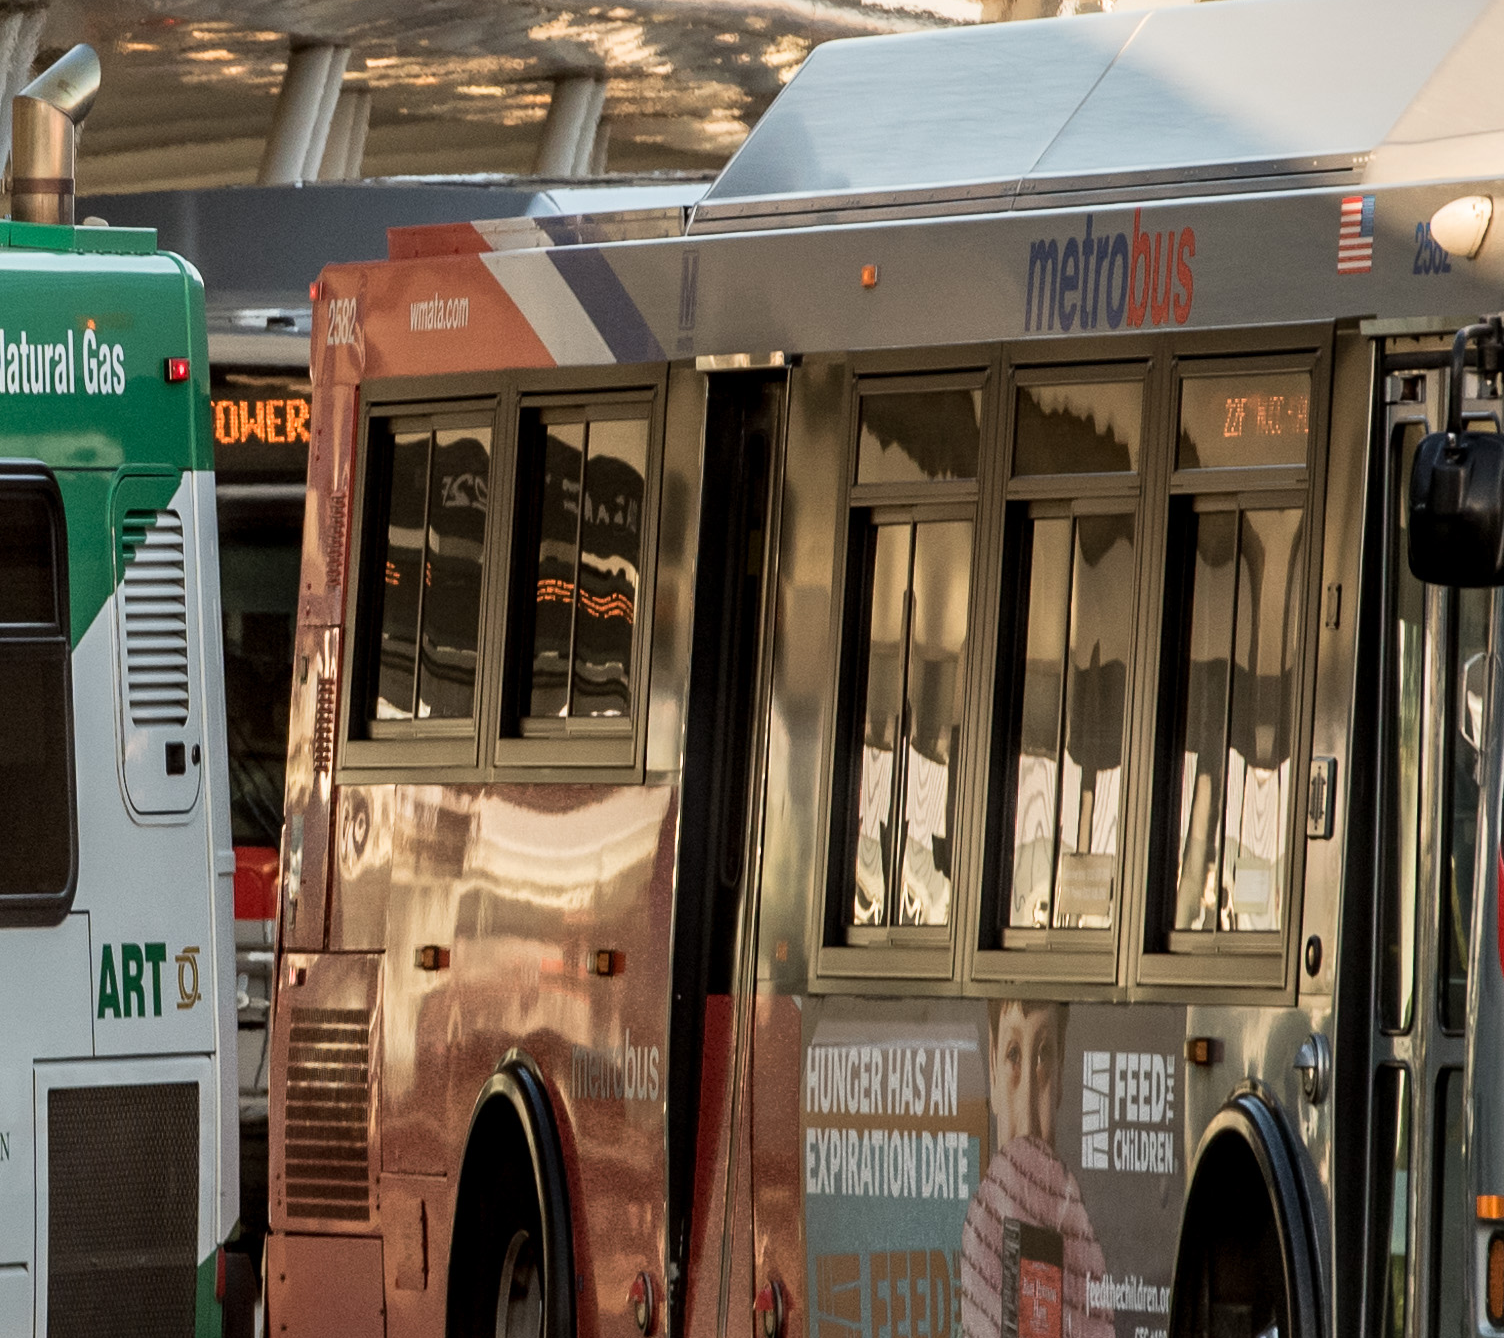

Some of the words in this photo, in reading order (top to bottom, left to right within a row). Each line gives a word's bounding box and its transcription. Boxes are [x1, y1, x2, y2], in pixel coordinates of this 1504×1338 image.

[1025, 207, 1196, 332] metrobus
[327, 297, 357, 346] 2582
[410, 292, 469, 332] wmata.com
[83, 328, 126, 396] Gas
[211, 398, 311, 445] OWER
[97, 942, 167, 1019] ART
[572, 1028, 660, 1102] metrobus
[806, 1046, 883, 1115] HUNGER
[888, 1048, 929, 1116] HAS
[929, 1048, 959, 1118] AN
[1114, 1052, 1166, 1124] FEED
[1166, 1054, 1175, 1126] THE
[806, 1128, 918, 1199] EXPIRATION
[921, 1131, 970, 1200] DATE
[1086, 1271, 1171, 1318] feedthechildren.or
